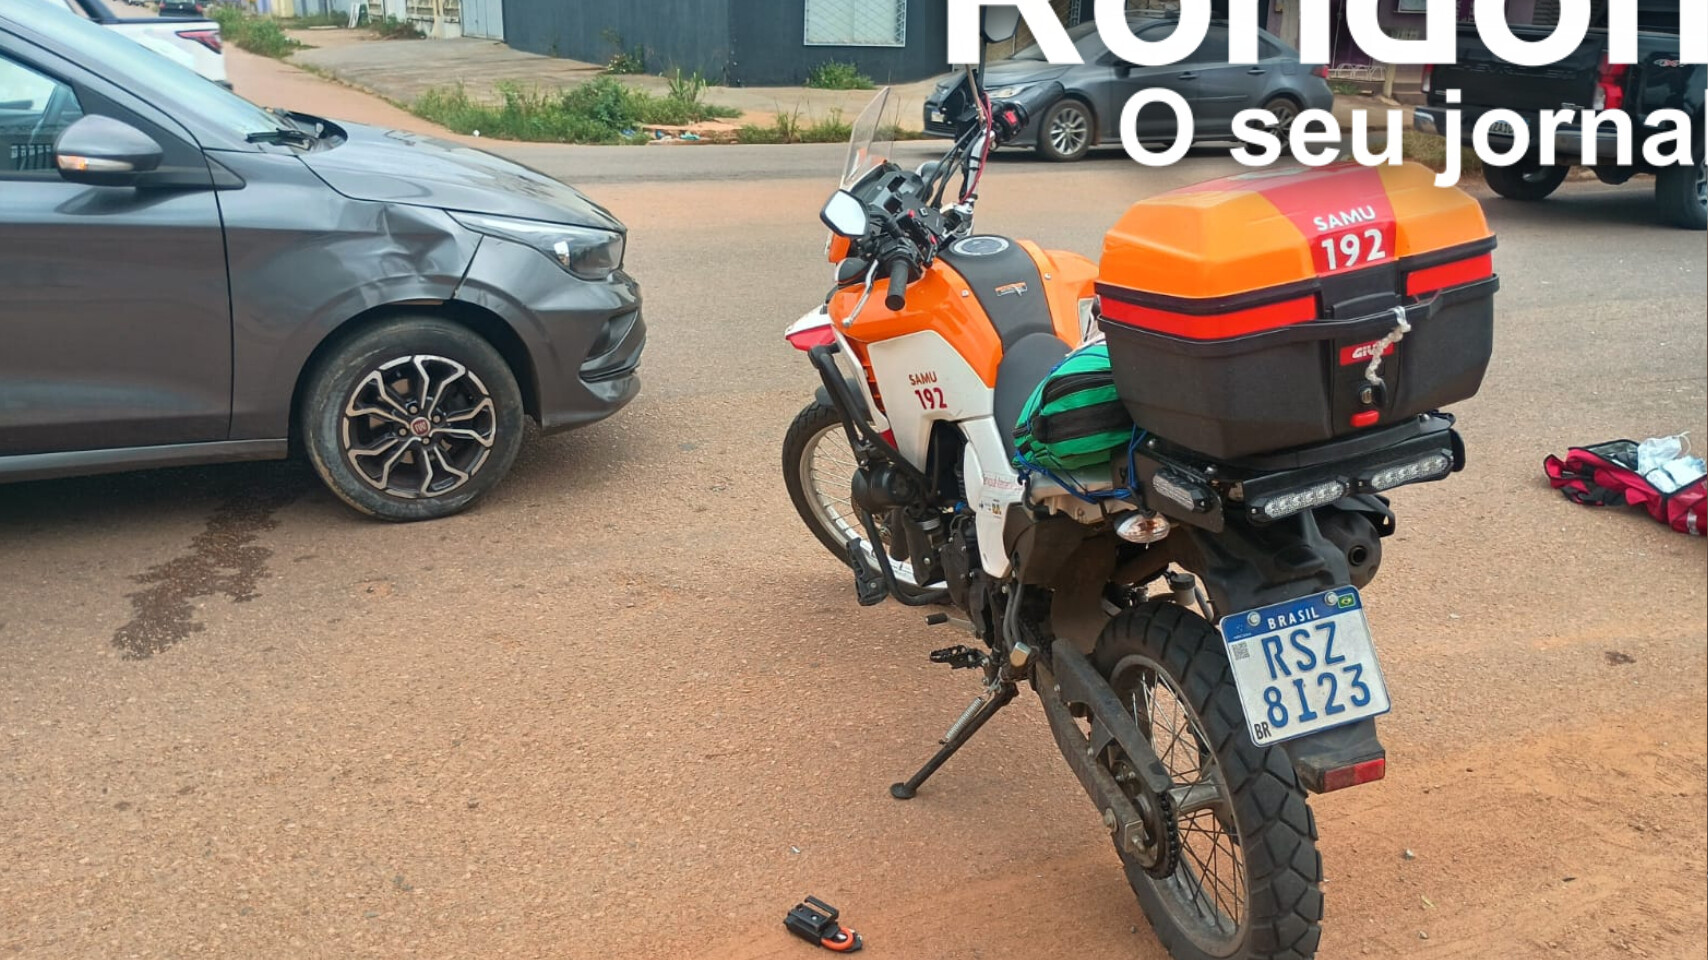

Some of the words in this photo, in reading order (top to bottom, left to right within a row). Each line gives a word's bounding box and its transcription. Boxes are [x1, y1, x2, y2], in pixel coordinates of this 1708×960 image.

[1313, 205, 1376, 231] SAMU
[1321, 228, 1386, 270] 192
[908, 371, 937, 386] SAMU
[914, 387, 948, 410] 192
[1267, 607, 1320, 630] BRASIL
[1261, 621, 1345, 680] RSZ
[1254, 721, 1272, 739] BR
